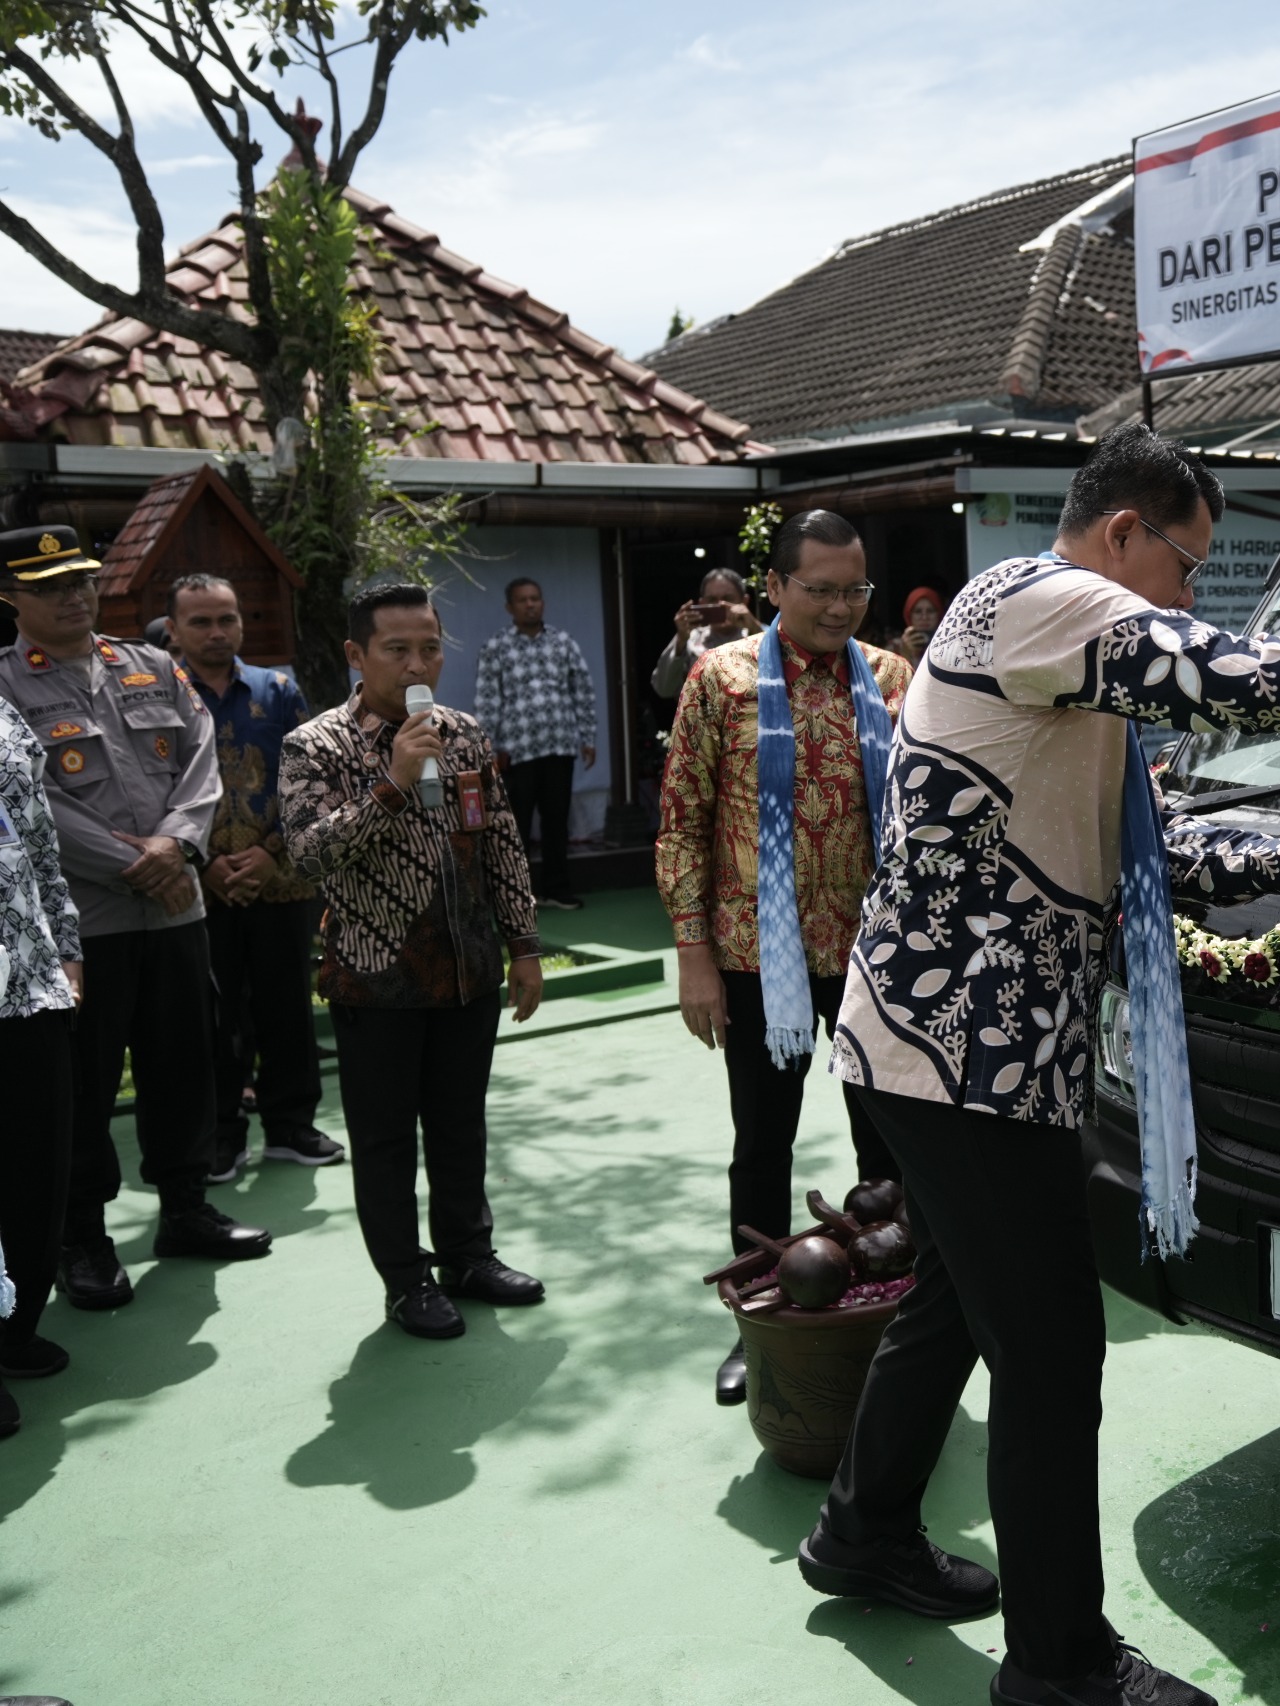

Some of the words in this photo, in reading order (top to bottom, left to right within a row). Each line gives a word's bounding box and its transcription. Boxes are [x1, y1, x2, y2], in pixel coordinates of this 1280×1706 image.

[1158, 231, 1233, 291] DARI
[1172, 282, 1278, 324] SINERGITAS
[122, 690, 169, 703] POLRI
